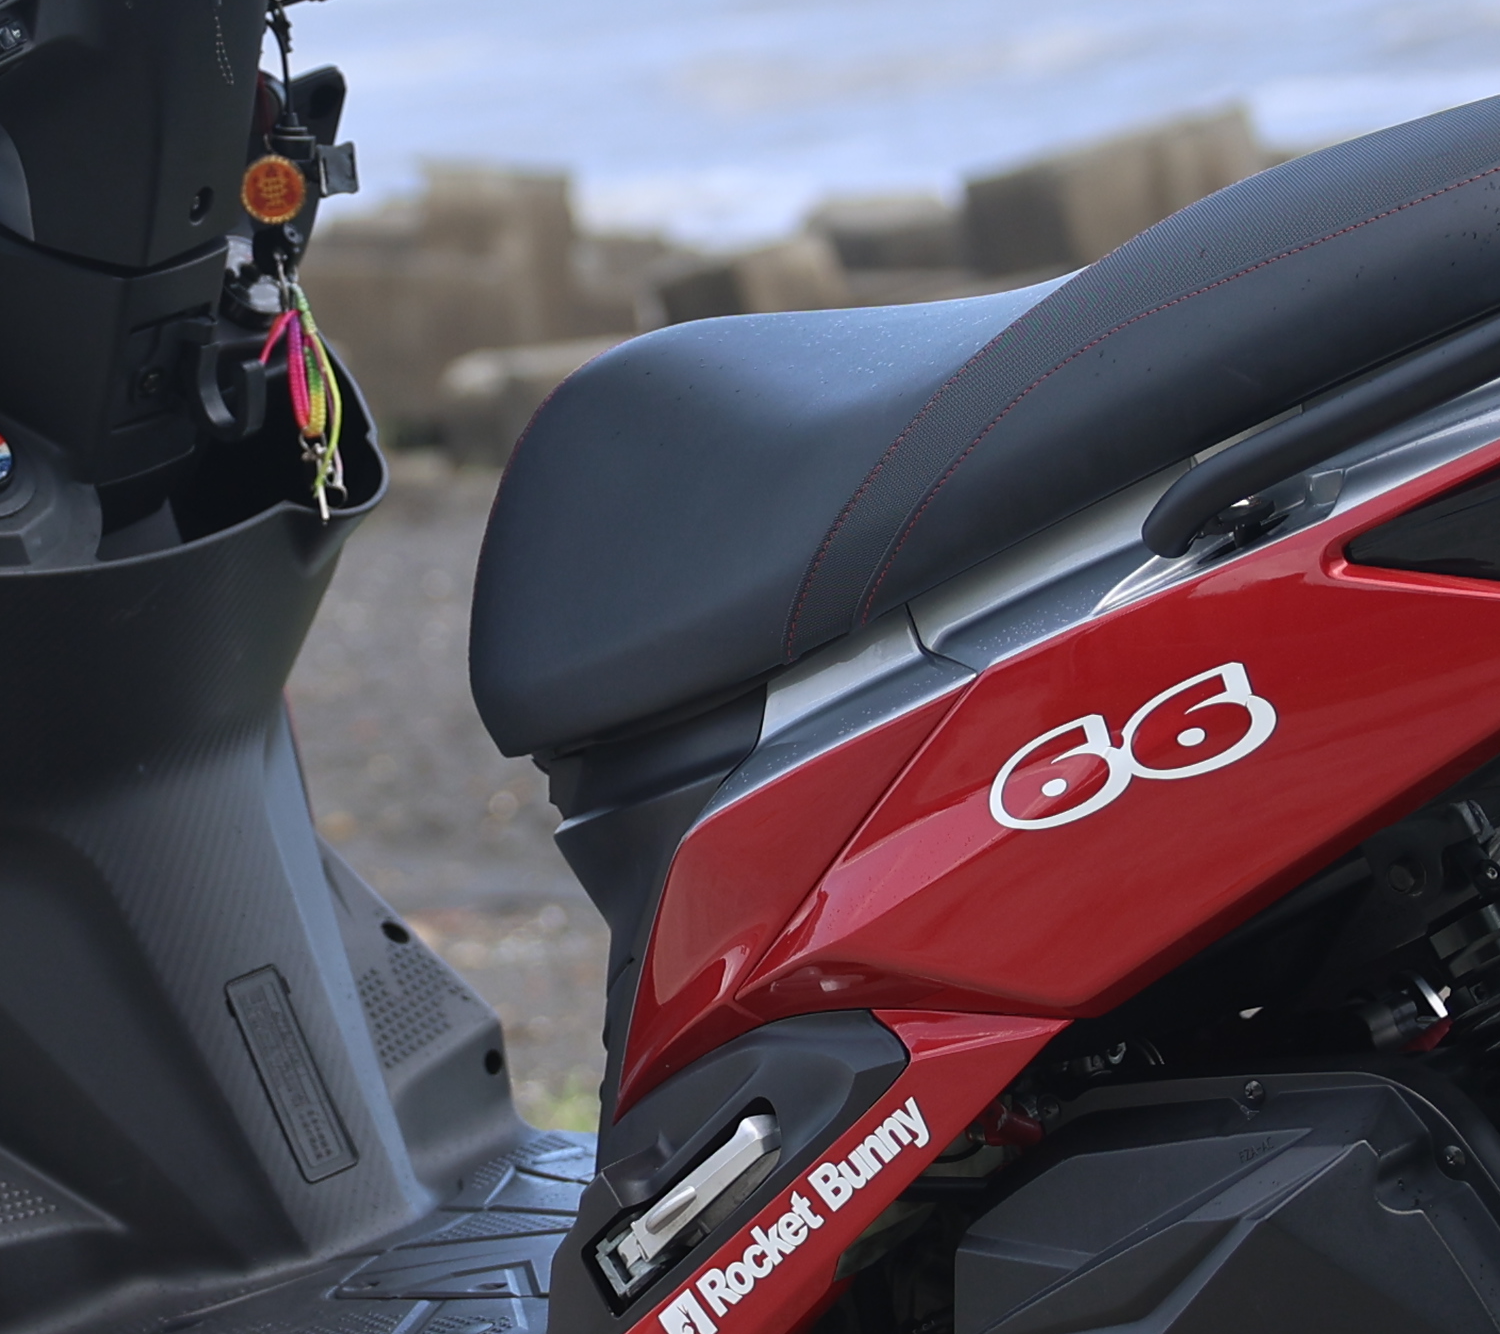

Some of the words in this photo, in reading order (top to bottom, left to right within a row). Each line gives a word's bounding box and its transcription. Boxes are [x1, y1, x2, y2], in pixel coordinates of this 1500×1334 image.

[989, 661, 1278, 831] 66
[695, 1190, 825, 1318] Rocket
[806, 1096, 931, 1213] Bunny
